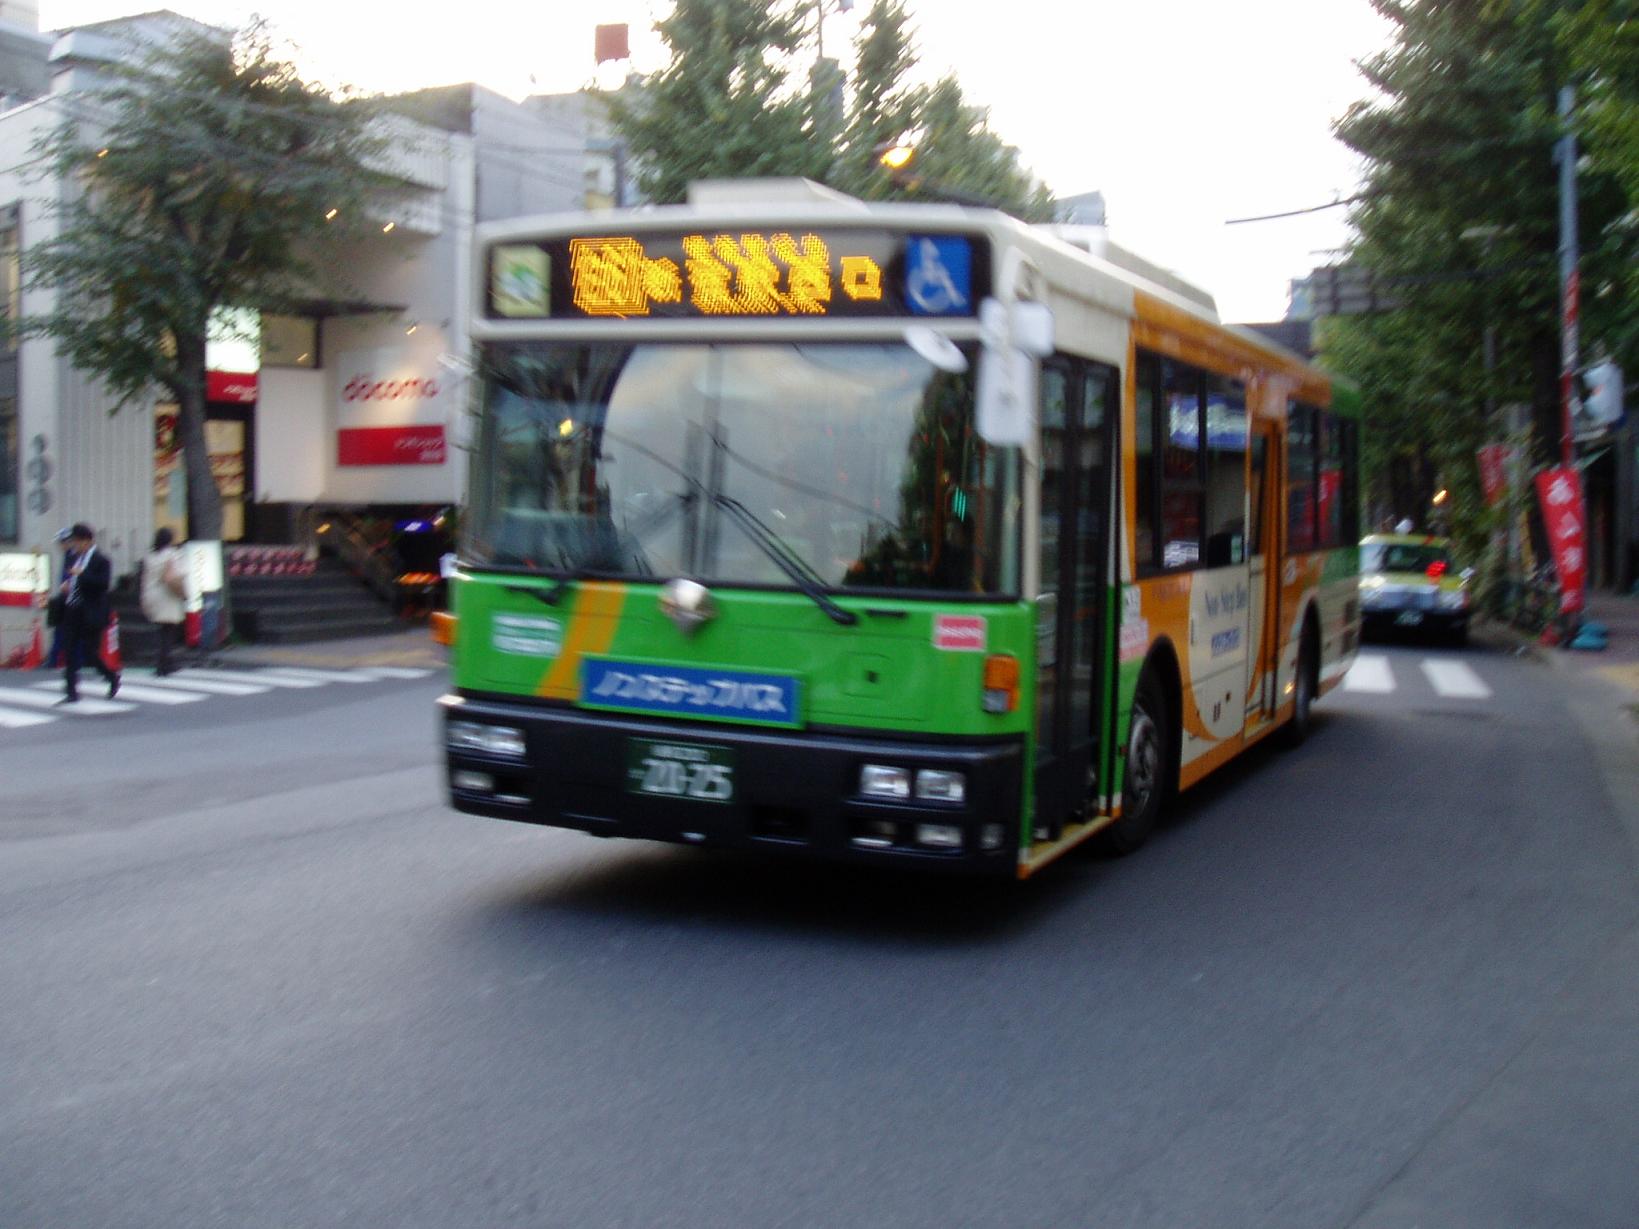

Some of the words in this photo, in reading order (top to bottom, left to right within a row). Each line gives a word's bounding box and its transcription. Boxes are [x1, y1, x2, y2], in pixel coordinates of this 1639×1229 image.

[592, 671, 787, 713] ノンステップバス
